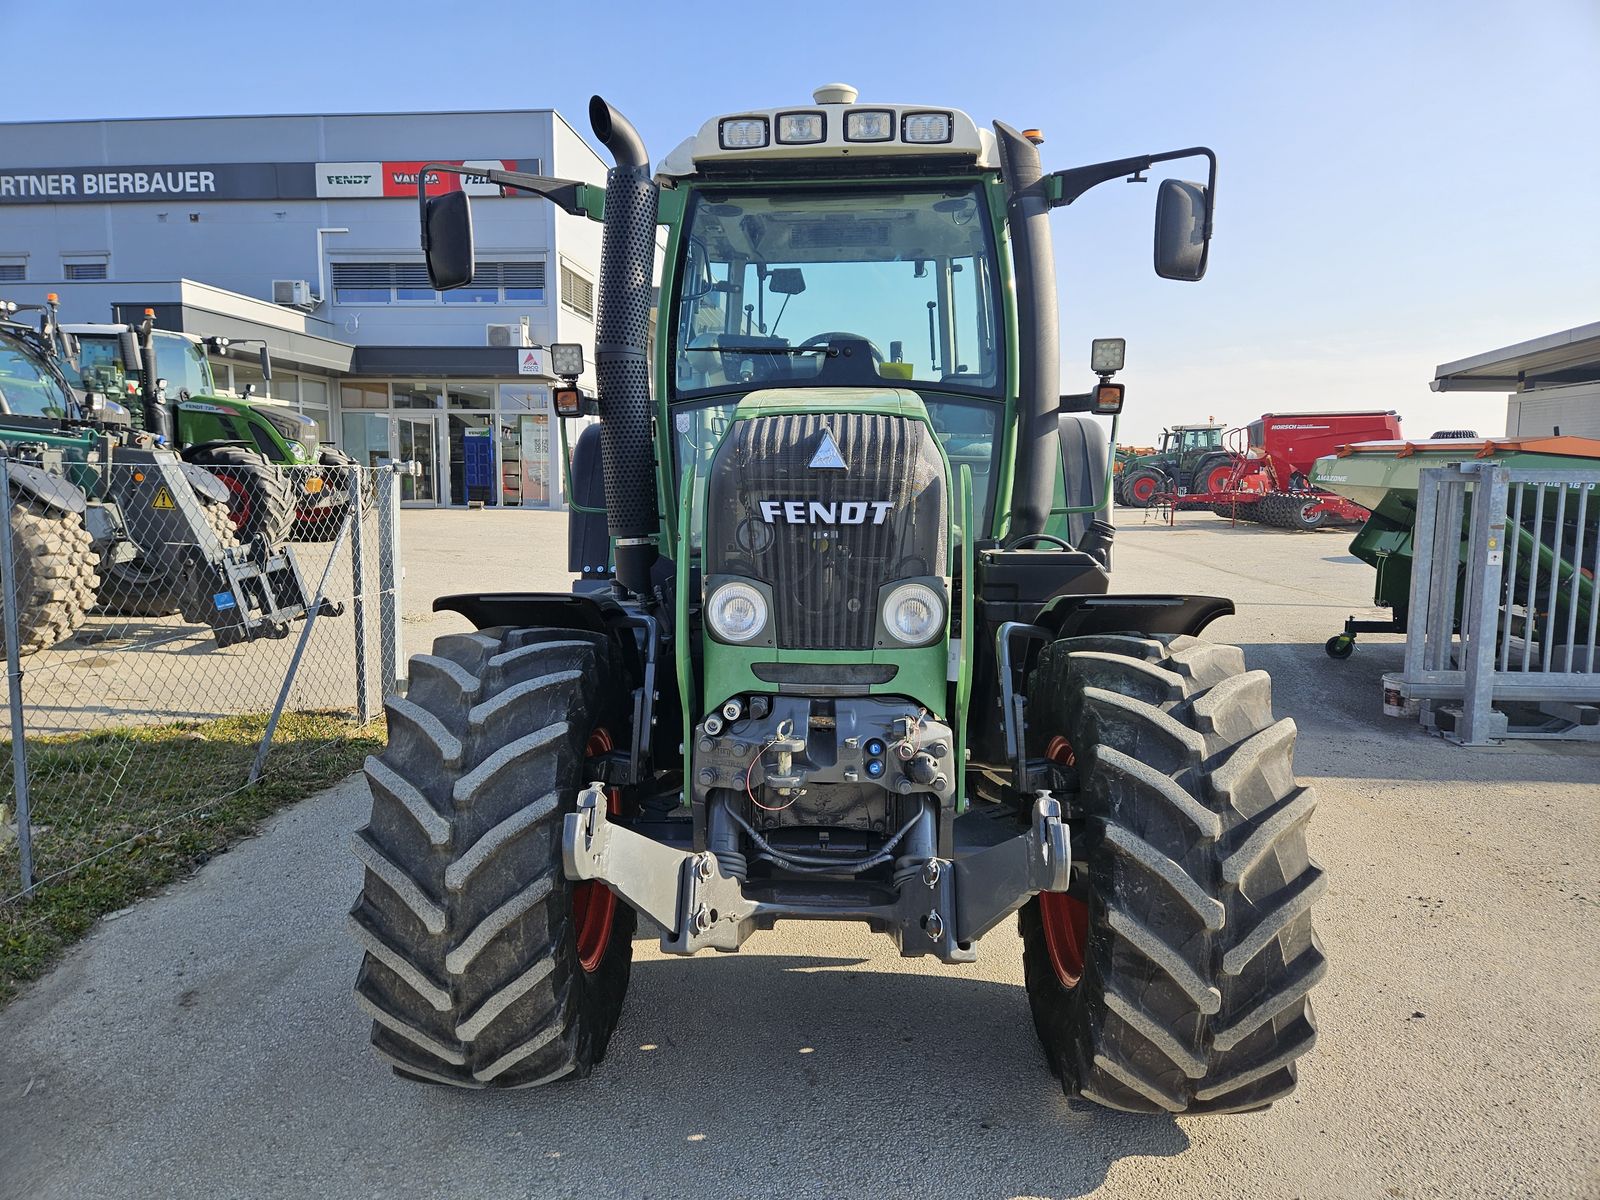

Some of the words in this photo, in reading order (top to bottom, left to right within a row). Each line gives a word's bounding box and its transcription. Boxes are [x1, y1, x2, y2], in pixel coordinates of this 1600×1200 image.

[0, 174, 76, 196] RTNER
[82, 171, 216, 195] BIERBAUER
[326, 175, 372, 185] FENDT
[392, 172, 440, 184] VALRA
[1568, 482, 1596, 490] 160
[759, 501, 896, 525] FENDT
